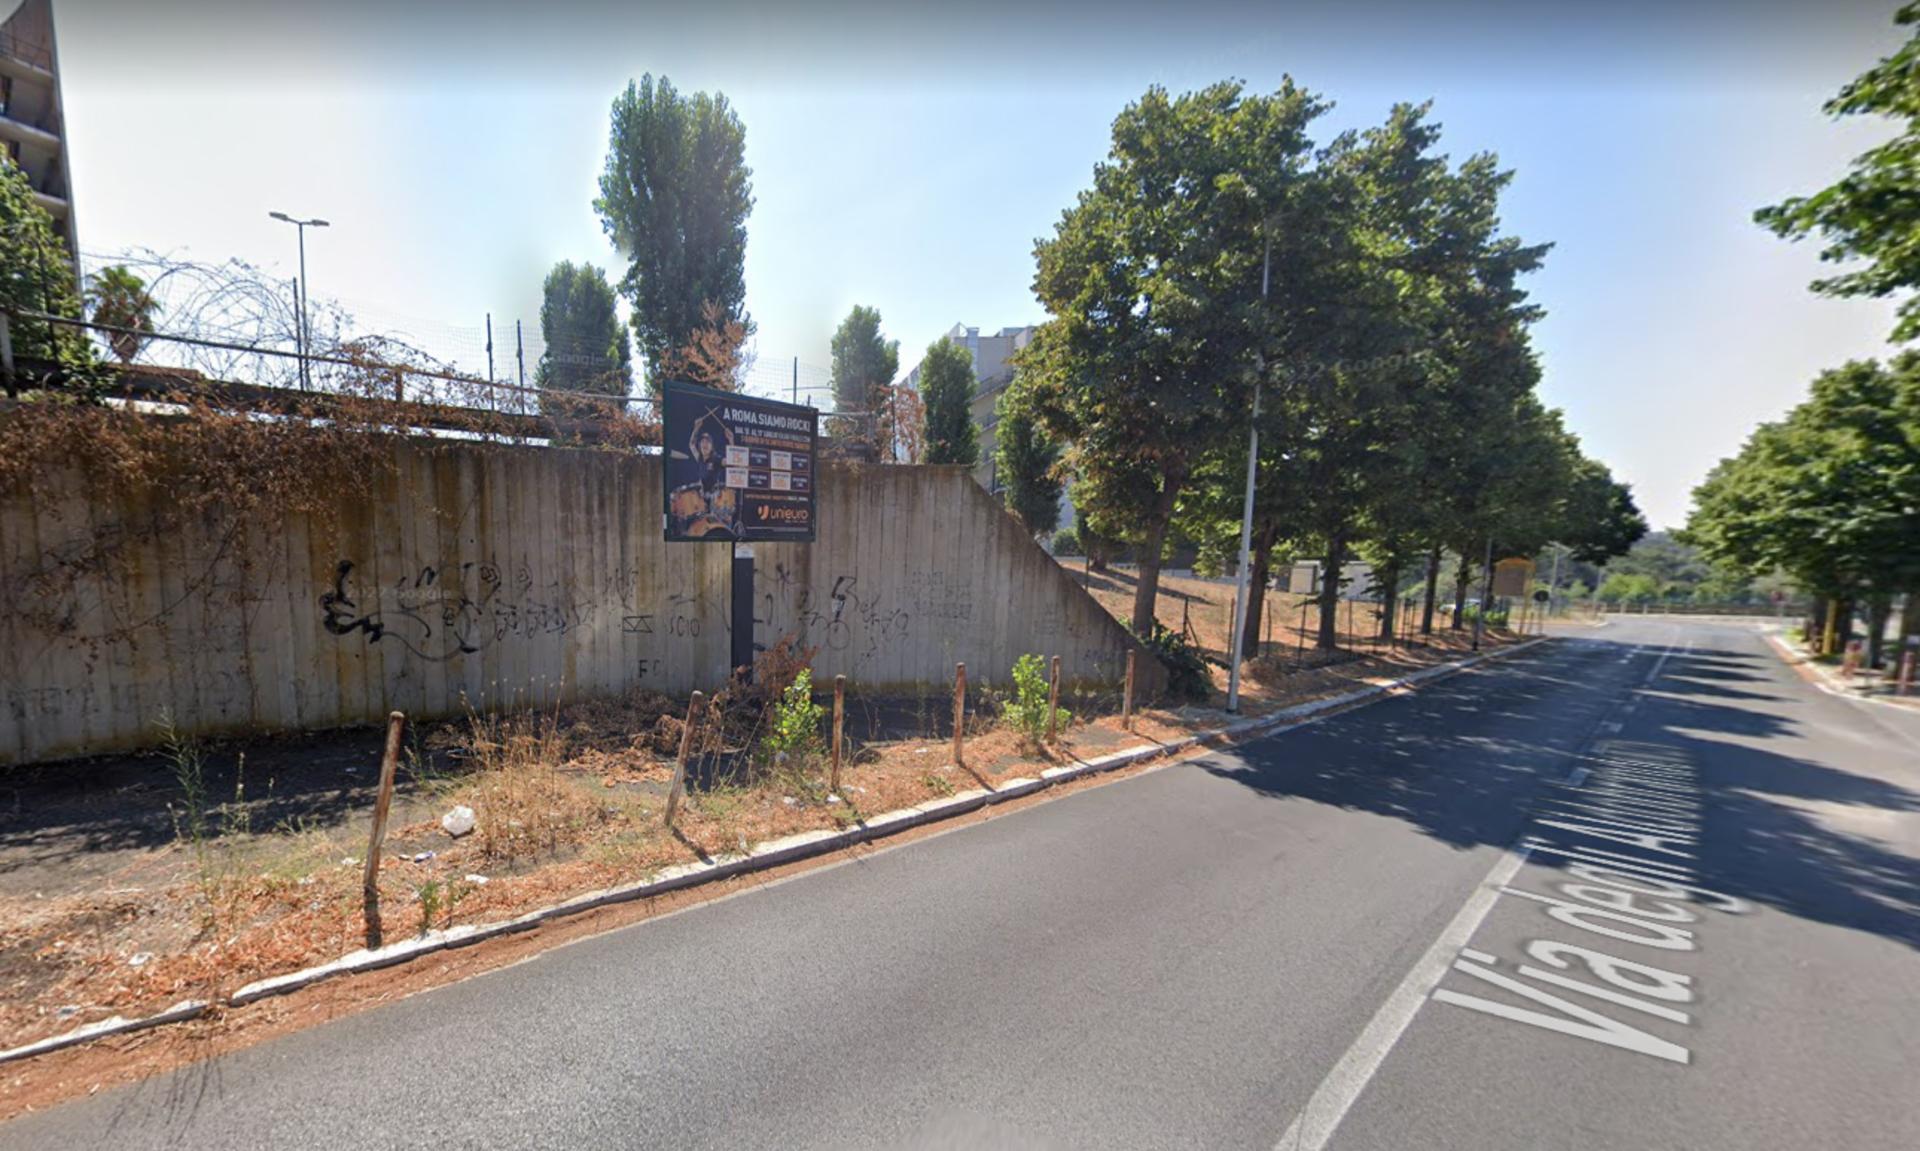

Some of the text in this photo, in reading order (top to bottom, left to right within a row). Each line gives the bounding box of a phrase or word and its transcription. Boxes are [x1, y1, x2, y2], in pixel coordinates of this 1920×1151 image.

[723, 407, 731, 419] A
[732, 409, 757, 425] ROMA
[758, 412, 787, 429] SIAMO
[770, 505, 809, 521] unieuro
